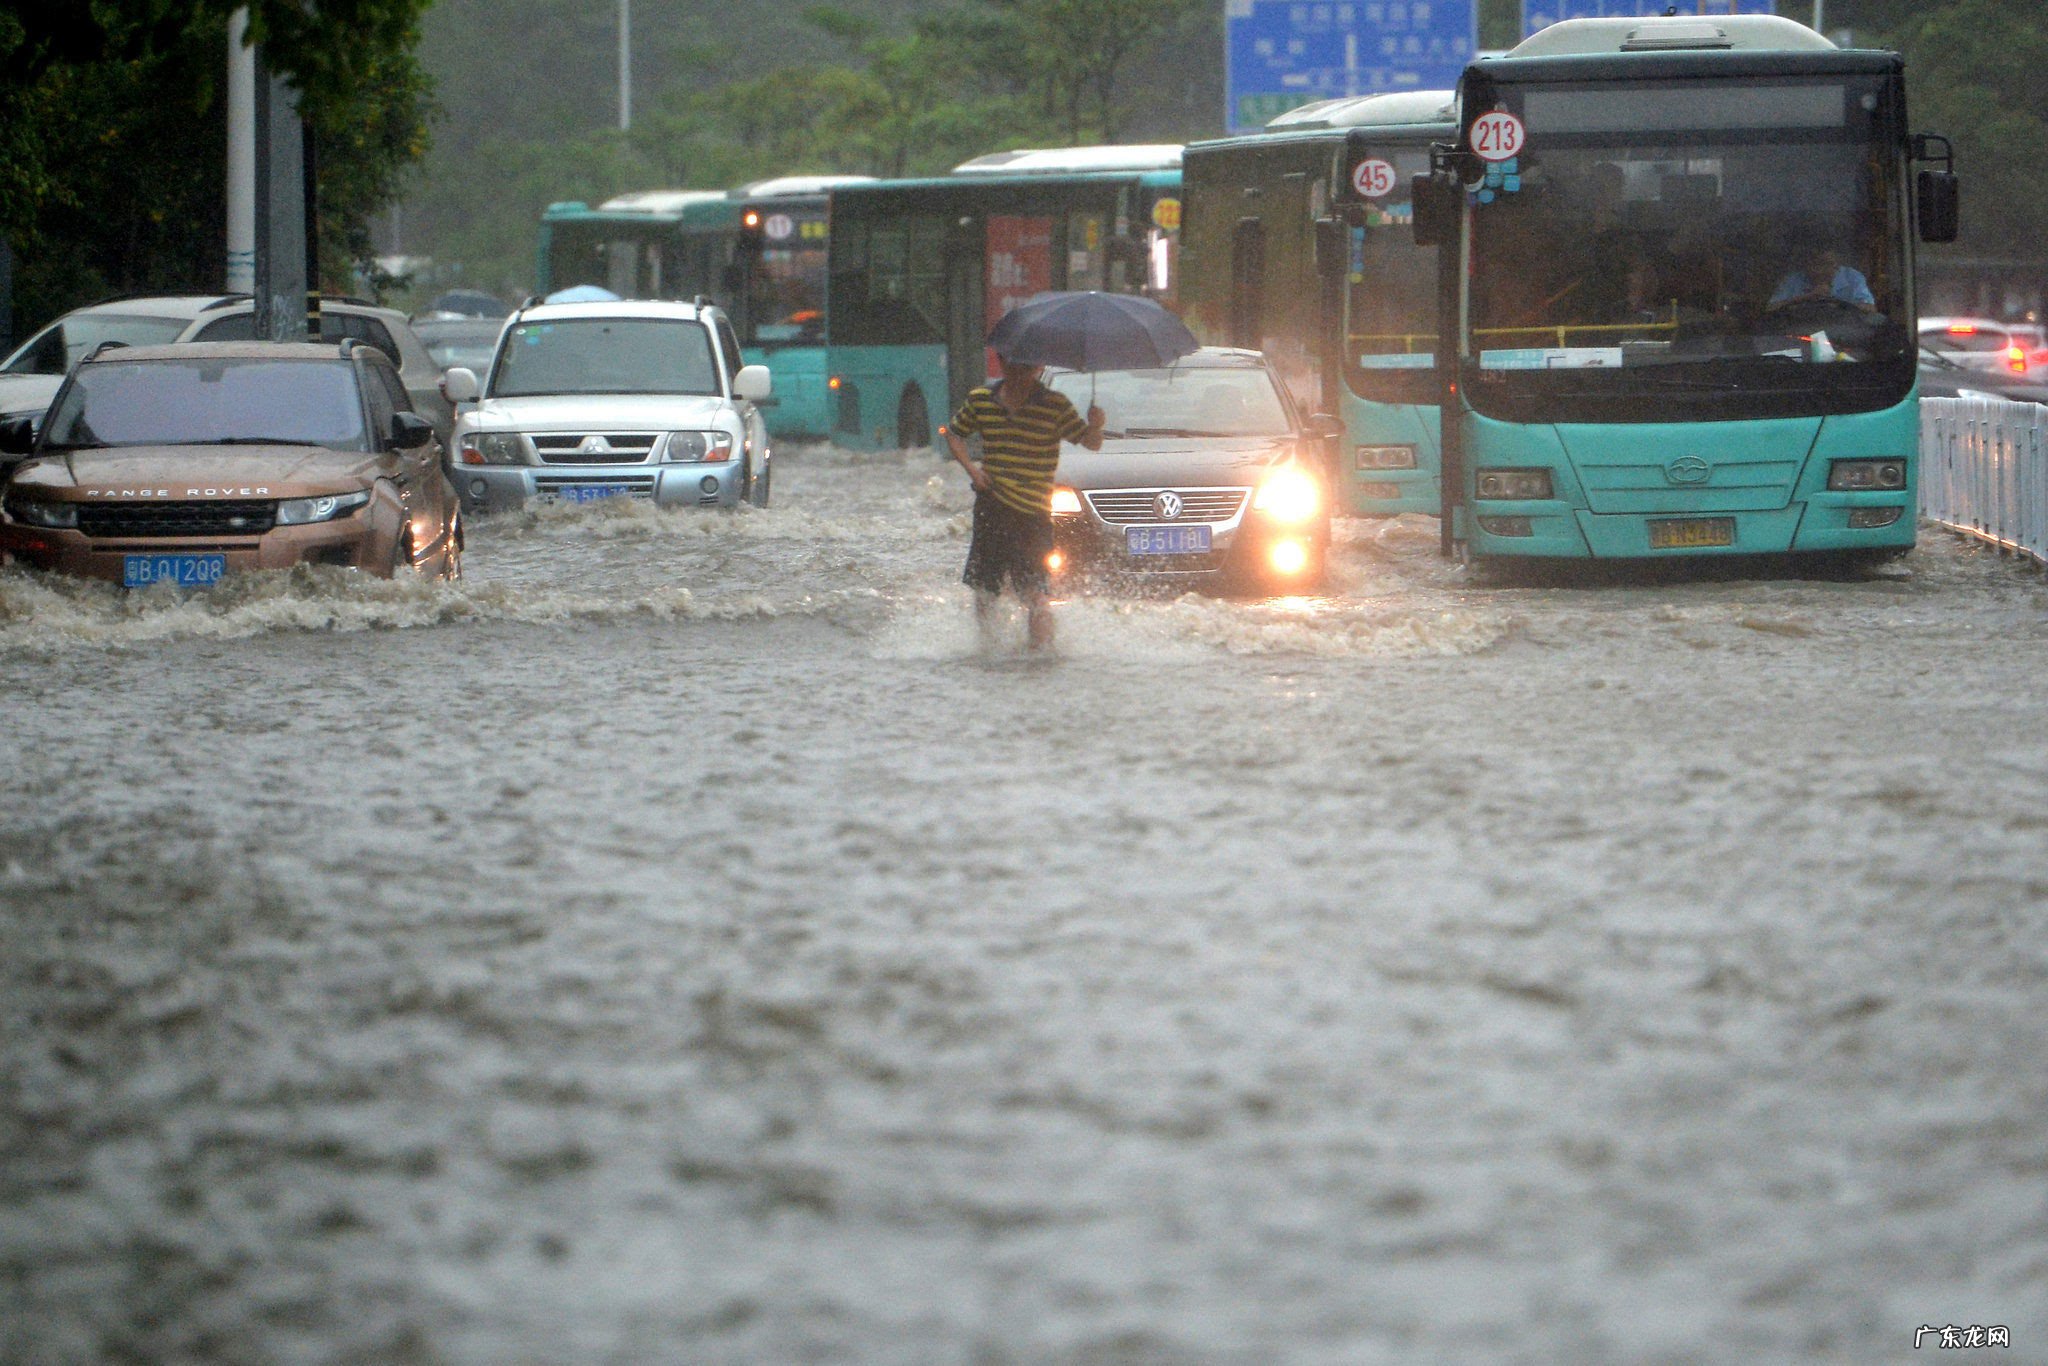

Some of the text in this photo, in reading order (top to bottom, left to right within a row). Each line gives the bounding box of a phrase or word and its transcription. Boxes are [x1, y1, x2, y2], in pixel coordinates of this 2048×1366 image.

[1478, 120, 1515, 152] 213
[1359, 164, 1389, 191] 45
[87, 486, 270, 498] RANGE ROVER
